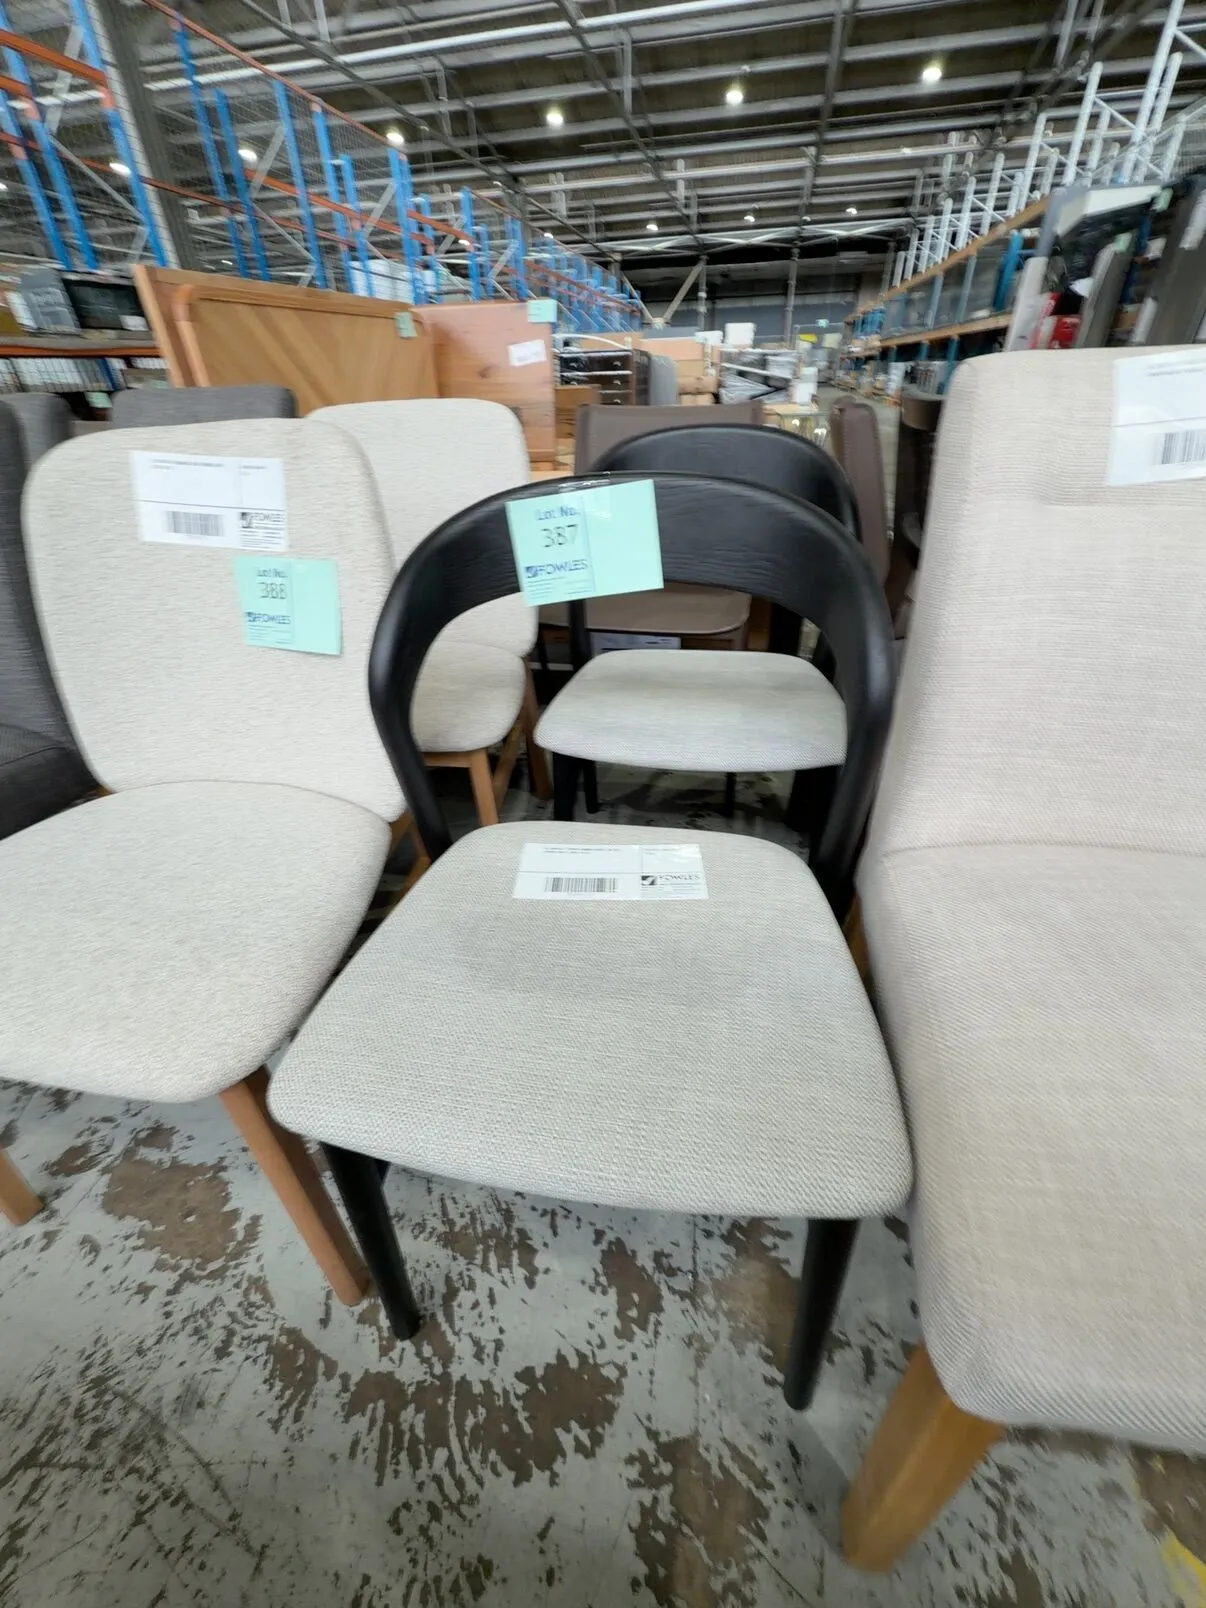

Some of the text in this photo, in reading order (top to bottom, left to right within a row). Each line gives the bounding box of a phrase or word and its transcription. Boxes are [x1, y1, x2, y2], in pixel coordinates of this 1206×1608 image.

[541, 524, 578, 548] 387
[537, 559, 588, 576] FOWLES
[258, 581, 287, 599] 388
[254, 613, 291, 625] FOWLES
